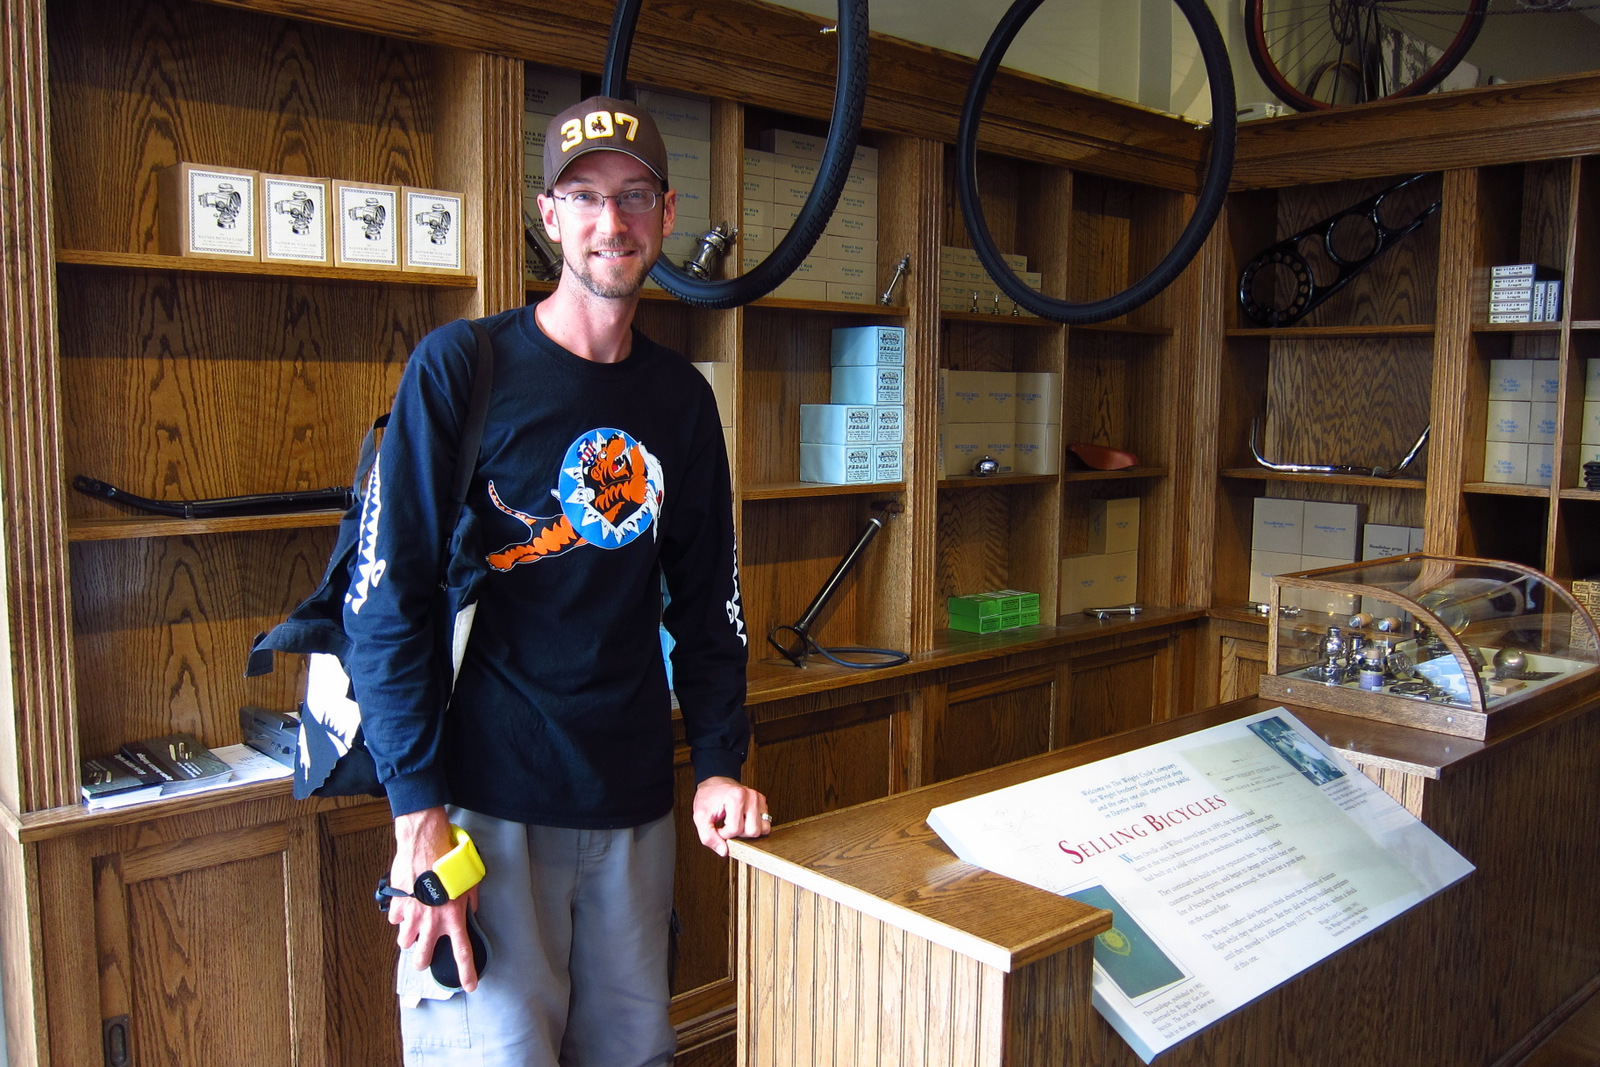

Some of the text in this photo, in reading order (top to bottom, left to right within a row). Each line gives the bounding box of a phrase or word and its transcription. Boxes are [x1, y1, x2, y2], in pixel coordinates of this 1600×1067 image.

[560, 110, 639, 152] 307
[1081, 786, 1105, 796] Welcome
[1121, 775, 1140, 783] Wright
[1097, 792, 1117, 800] Wright
[1154, 774, 1171, 782] bicycle
[1175, 776, 1191, 785] public
[1110, 807, 1130, 816] Dayton
[1058, 794, 1227, 864] SELLING BICYCLES
[422, 878, 440, 901] Kodak
[1211, 925, 1229, 935] Wright
